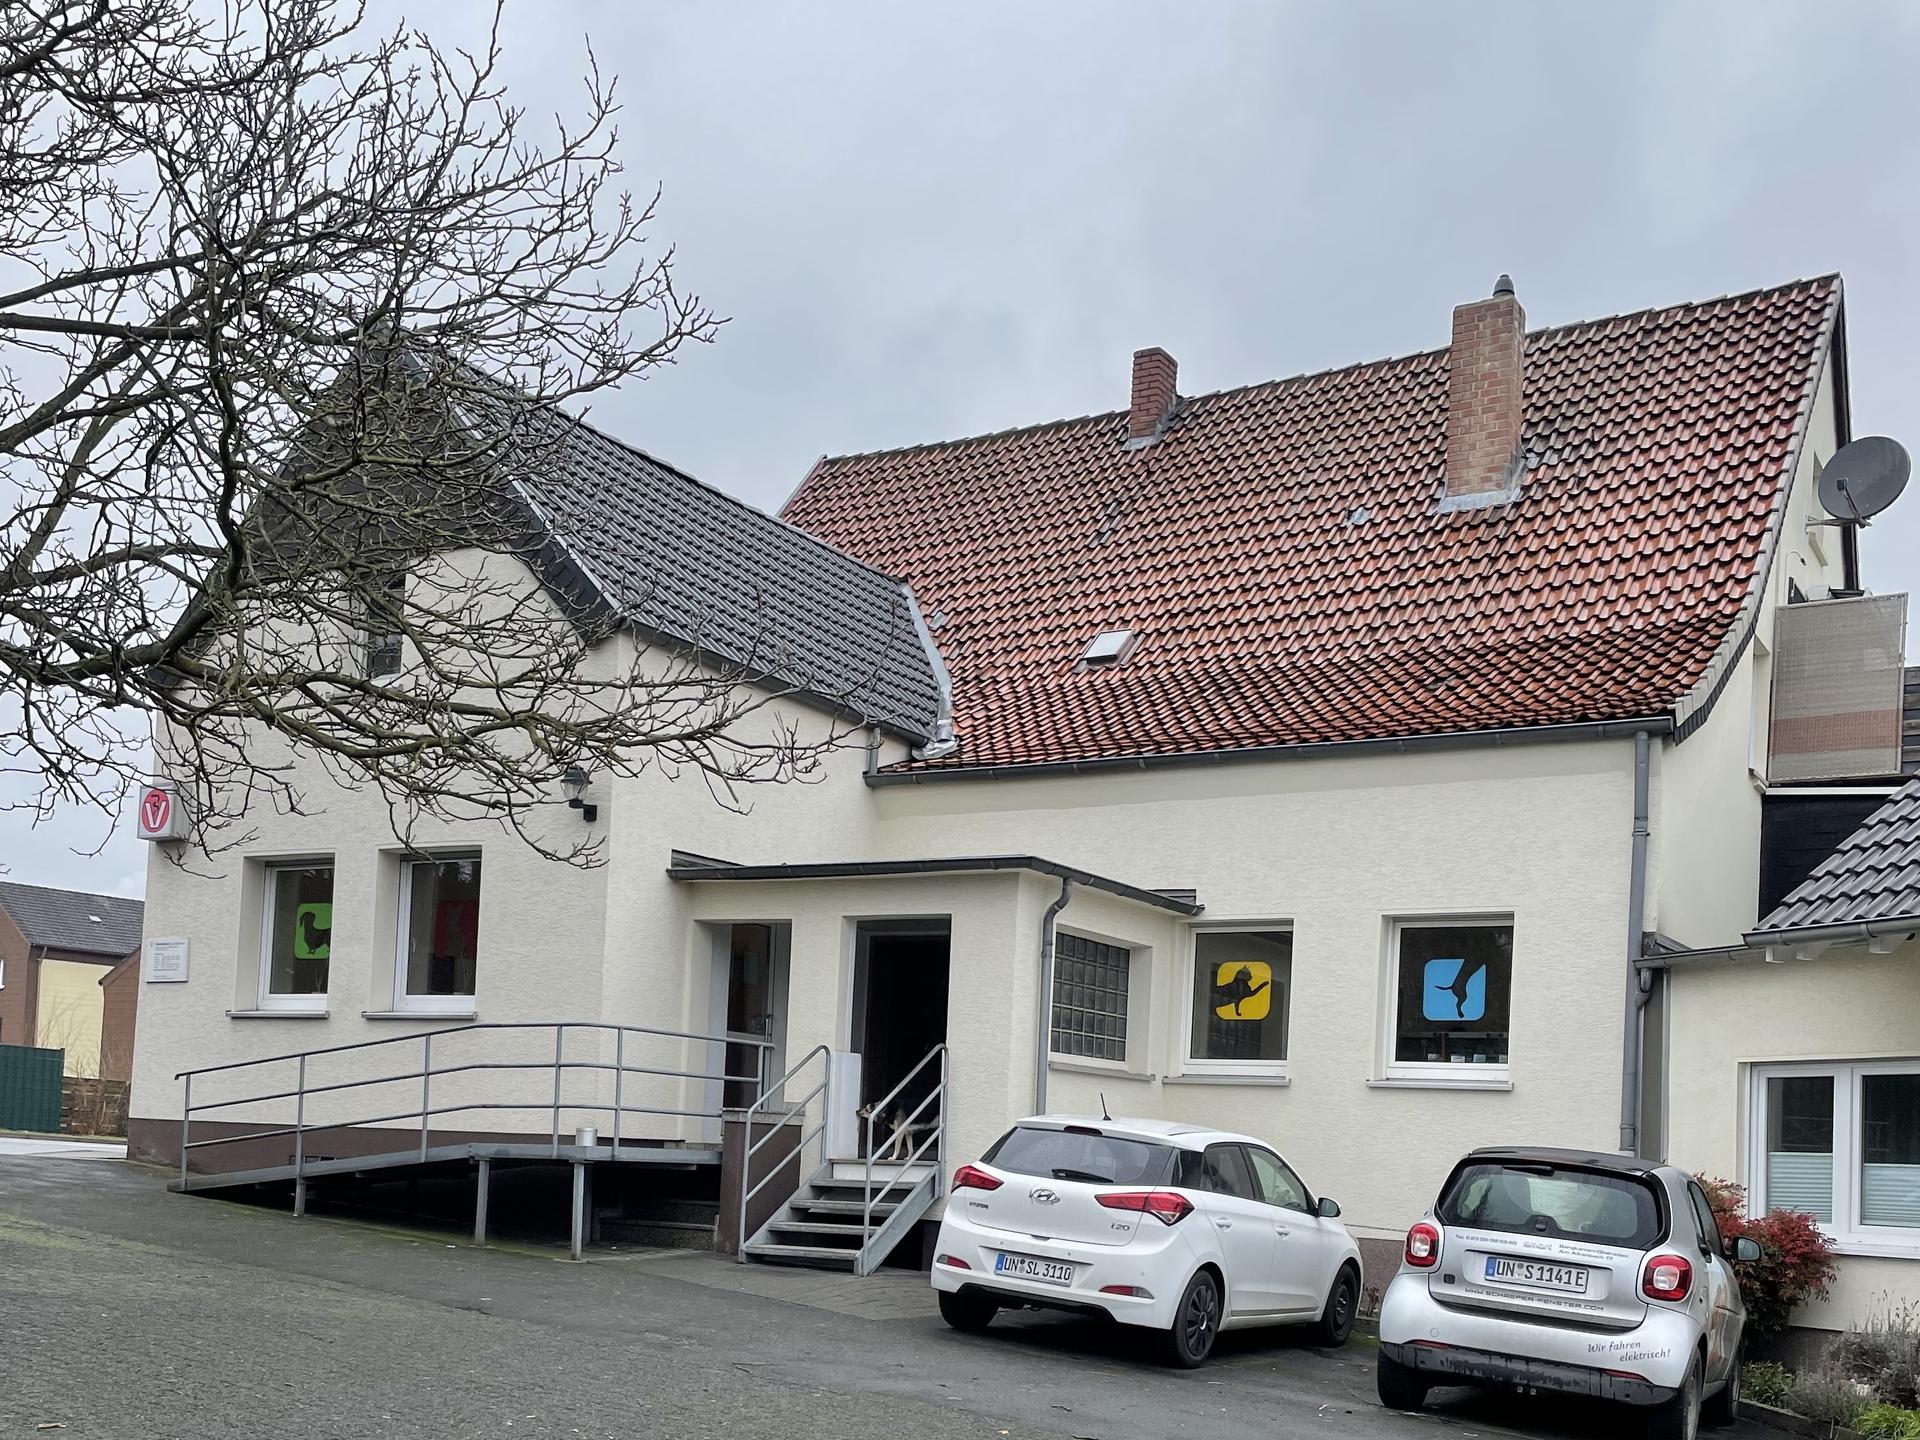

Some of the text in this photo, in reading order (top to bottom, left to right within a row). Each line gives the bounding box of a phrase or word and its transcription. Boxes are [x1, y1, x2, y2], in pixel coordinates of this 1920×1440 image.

[1003, 1257, 1072, 1281] UN SL 3110
[1496, 1260, 1516, 1277] UN
[1588, 1340, 1641, 1353] Wir fahren
[1619, 1348, 1671, 1362] elektrisch!
